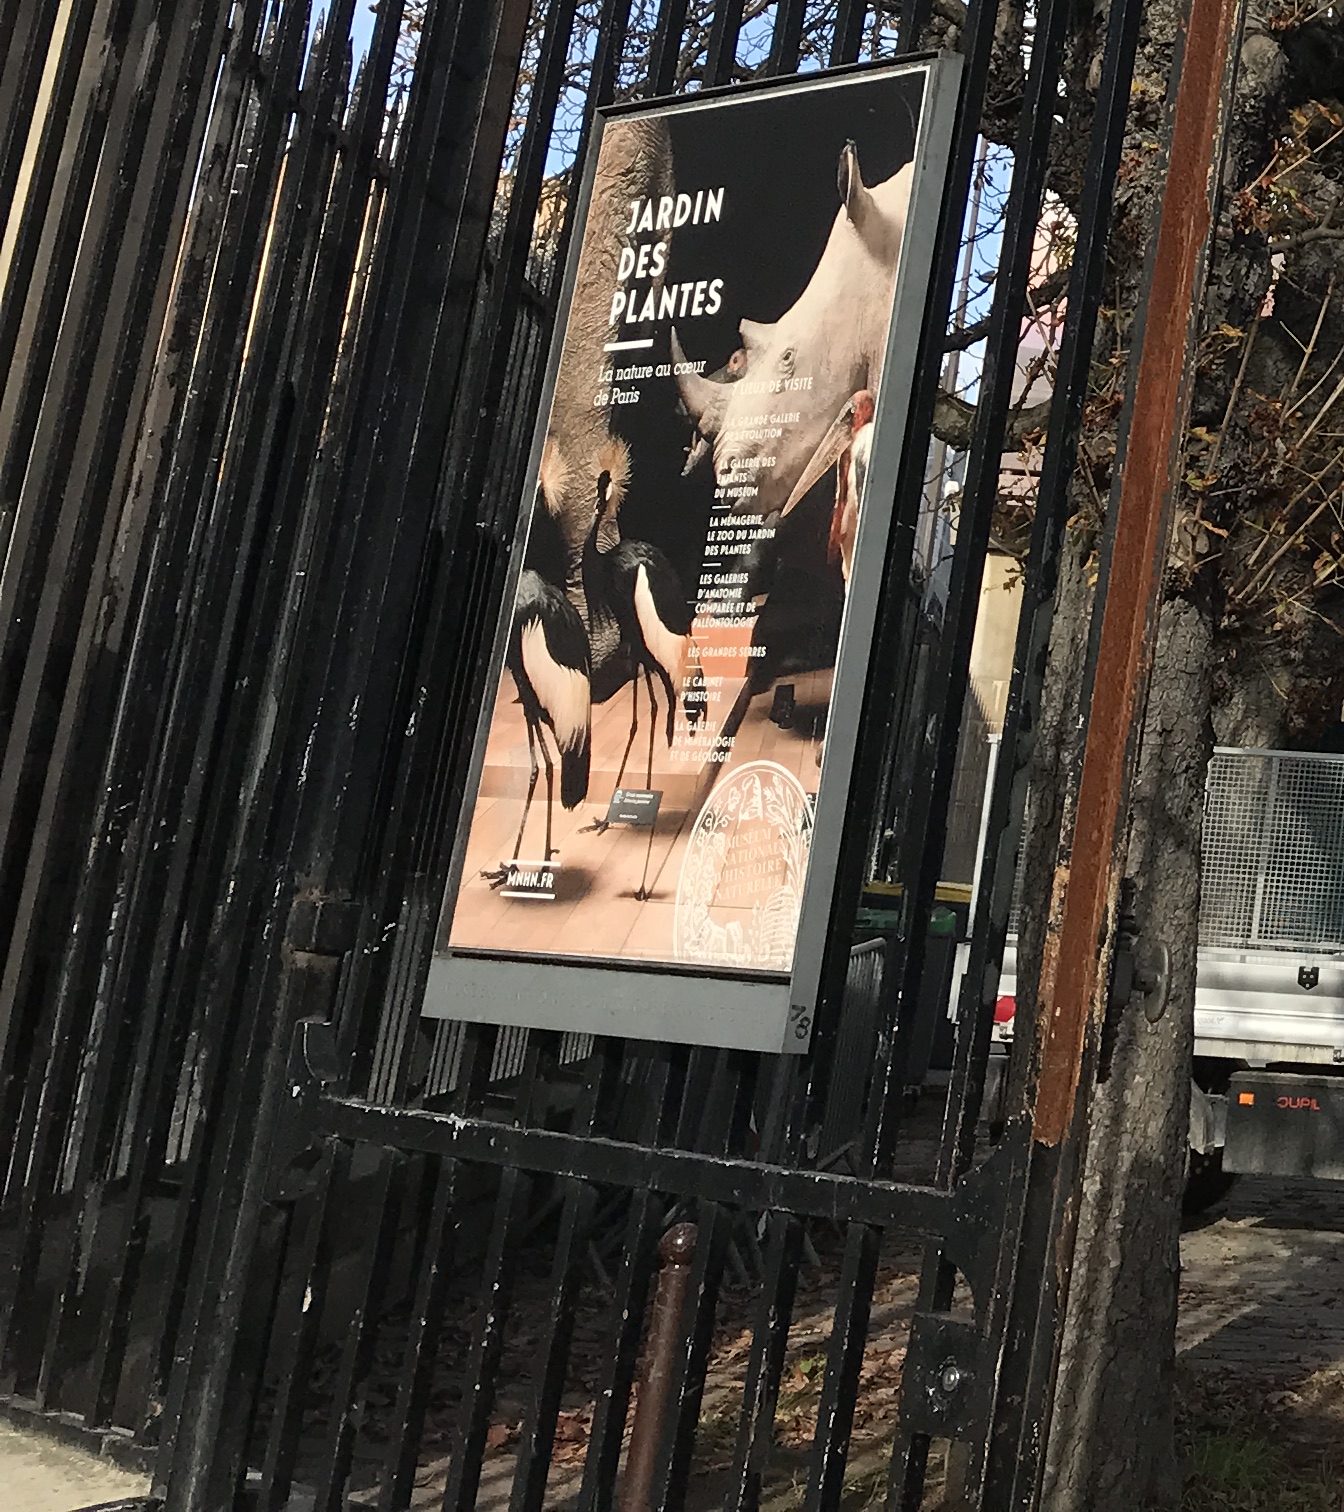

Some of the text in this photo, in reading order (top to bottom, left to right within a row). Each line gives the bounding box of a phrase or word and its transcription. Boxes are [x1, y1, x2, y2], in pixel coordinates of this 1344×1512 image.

[625, 187, 725, 235] JARDIN
[617, 242, 668, 281] DES
[608, 278, 725, 326] PLANTES
[597, 364, 614, 383] La
[616, 364, 654, 381] nature
[656, 364, 672, 377] au
[769, 379, 782, 393] DE
[784, 376, 814, 391] VISITE
[593, 386, 641, 407] de Paris
[769, 411, 801, 424] GALERIE
[719, 456, 777, 470] LA GALERIE DES
[714, 485, 759, 499] DU MUSÉUM
[709, 513, 765, 528] LA MÉNAGERIE,
[707, 528, 777, 542] LE ZOO DU JARDIN
[704, 543, 752, 556] DES PLANTES
[699, 572, 749, 585] LES GALERIES
[697, 588, 743, 600] D'ANATOMIE
[694, 601, 756, 614] COMPARÉE ET DE
[692, 615, 755, 628] PALÉONTOLOGIE
[687, 646, 767, 658] LES GRANDES SERRES
[682, 676, 724, 688] LE CABINET
[679, 691, 722, 702] D'HISTOIRE
[686, 720, 717, 732] GALERIE
[691, 750, 733, 763] GÉOLOGIE
[506, 870, 554, 889] MNHN.FR
